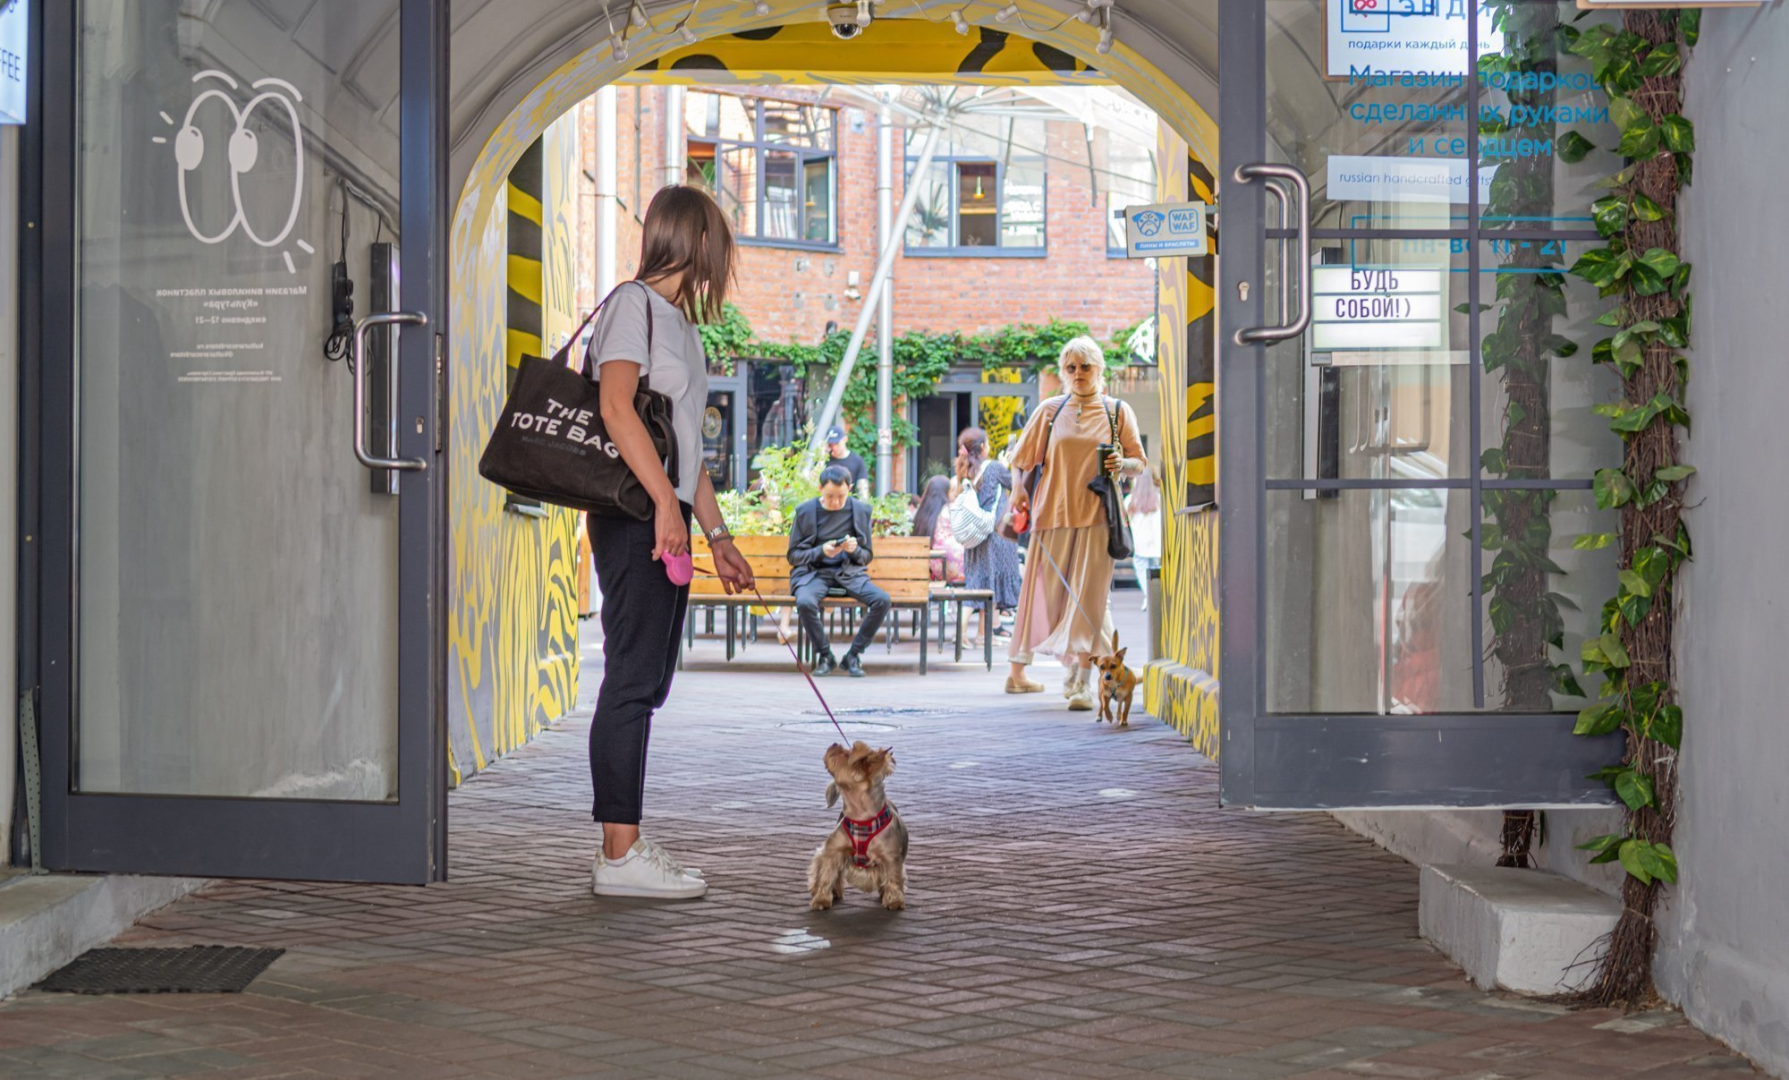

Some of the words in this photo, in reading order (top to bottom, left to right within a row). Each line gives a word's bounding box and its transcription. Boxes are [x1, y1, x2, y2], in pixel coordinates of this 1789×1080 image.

[1348, 40, 1401, 50] подарки
[1405, 38, 1456, 50] каждый
[1460, 40, 1490, 50] днь
[1349, 64, 1463, 88] Магазин
[1510, 105, 1609, 127] руками
[1408, 137, 1424, 155] и
[1434, 137, 1552, 160] седцем
[1339, 172, 1380, 183] russian
[1384, 173, 1462, 185] handcrafted
[1172, 212, 1195, 221] WAF
[1173, 221, 1195, 231] WAF
[1351, 270, 1399, 293] БУДЬ
[547, 398, 594, 426] THE
[511, 412, 562, 436] TOTE
[566, 424, 620, 459] BAG
